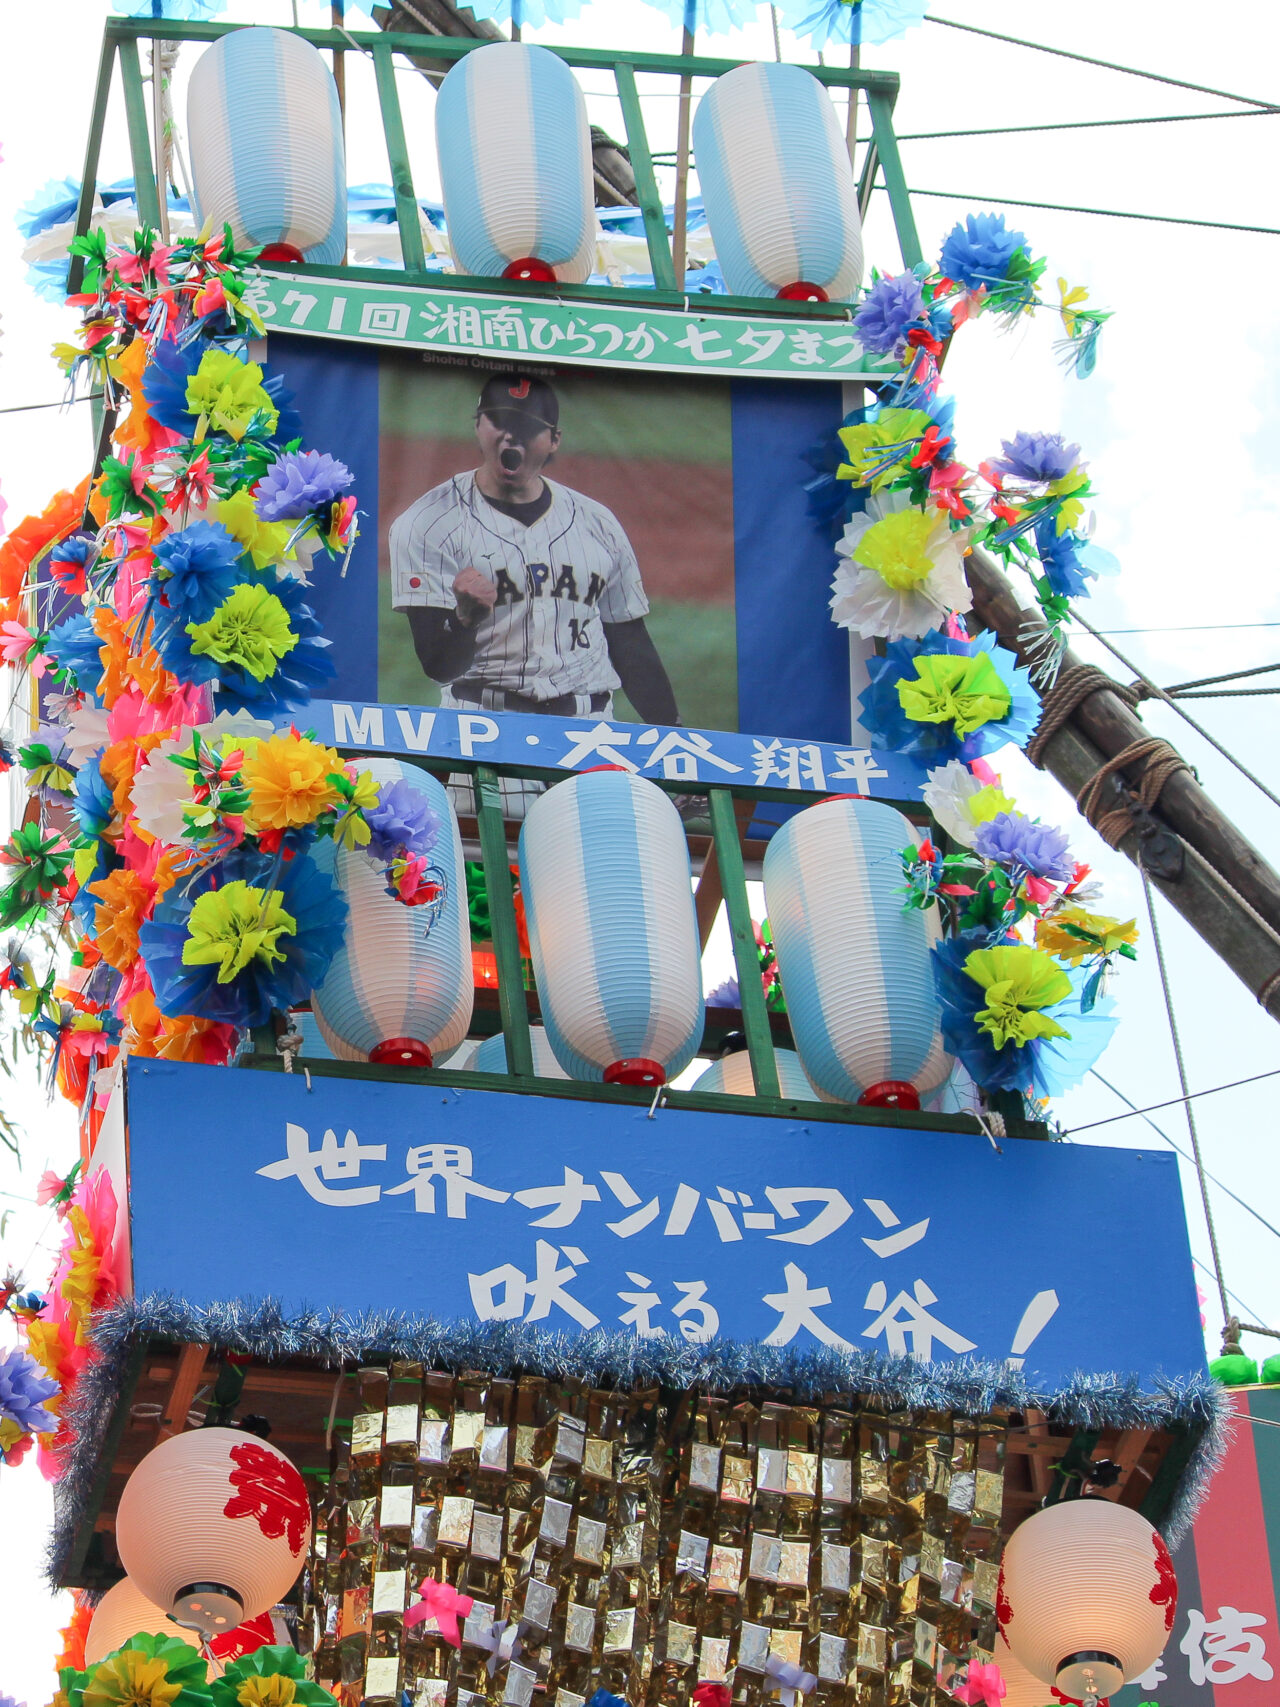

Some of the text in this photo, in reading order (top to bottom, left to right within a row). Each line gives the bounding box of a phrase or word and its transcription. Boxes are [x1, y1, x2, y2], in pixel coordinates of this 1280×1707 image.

[240, 277, 900, 369] 第71回湘南ひらつか七夕まつ
[422, 352, 468, 367] Shohei
[470, 358, 514, 373] Ohtani
[494, 562, 606, 606] APAN
[255, 1122, 930, 1258] 世界ナンバーワン
